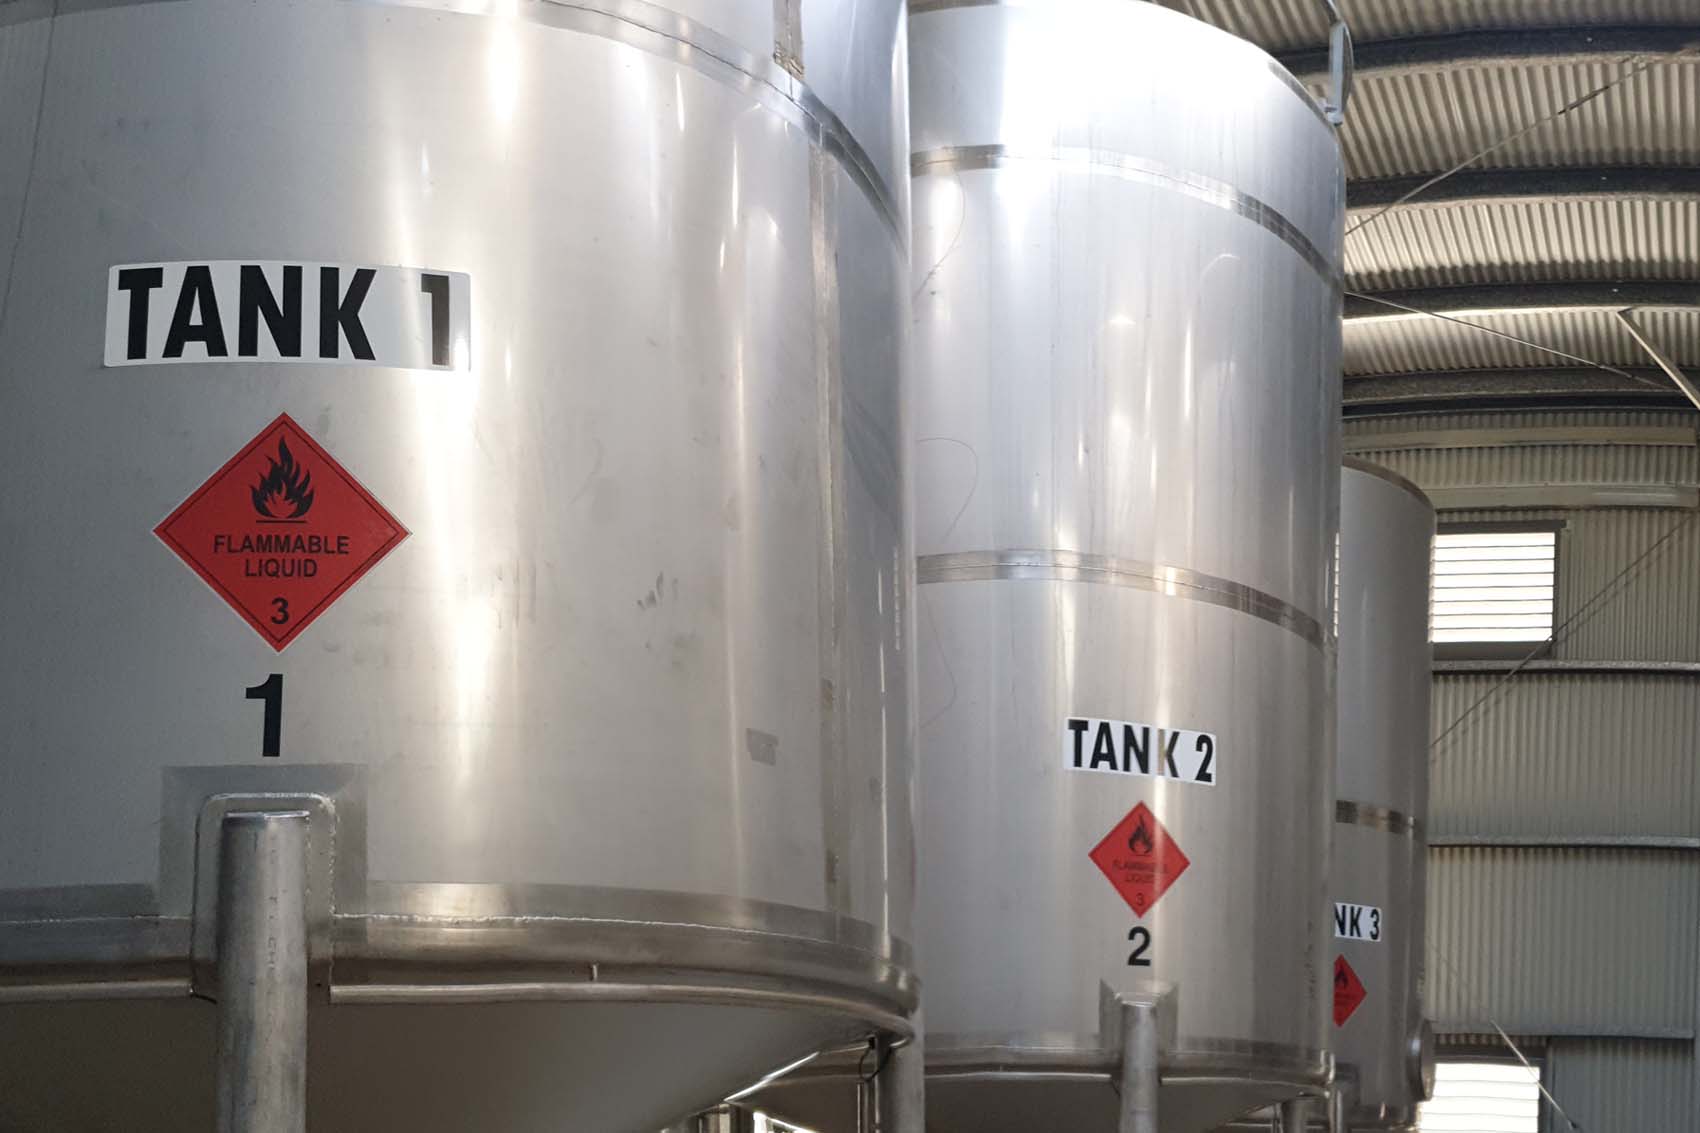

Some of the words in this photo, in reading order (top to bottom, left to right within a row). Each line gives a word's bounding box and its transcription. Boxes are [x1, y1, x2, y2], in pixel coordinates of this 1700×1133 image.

[117, 264, 377, 361] TANK
[420, 272, 451, 366] 1
[213, 534, 350, 556] FLAMMABLE
[244, 558, 318, 579] LIQUID
[270, 597, 290, 625] 3
[245, 673, 284, 758] 1
[1067, 718, 1181, 779] TANK
[1194, 734, 1214, 783] 2
[1136, 892, 1145, 906] 3
[1335, 904, 1363, 938] NK
[1369, 908, 1380, 941] 3
[1127, 926, 1152, 967] 2
